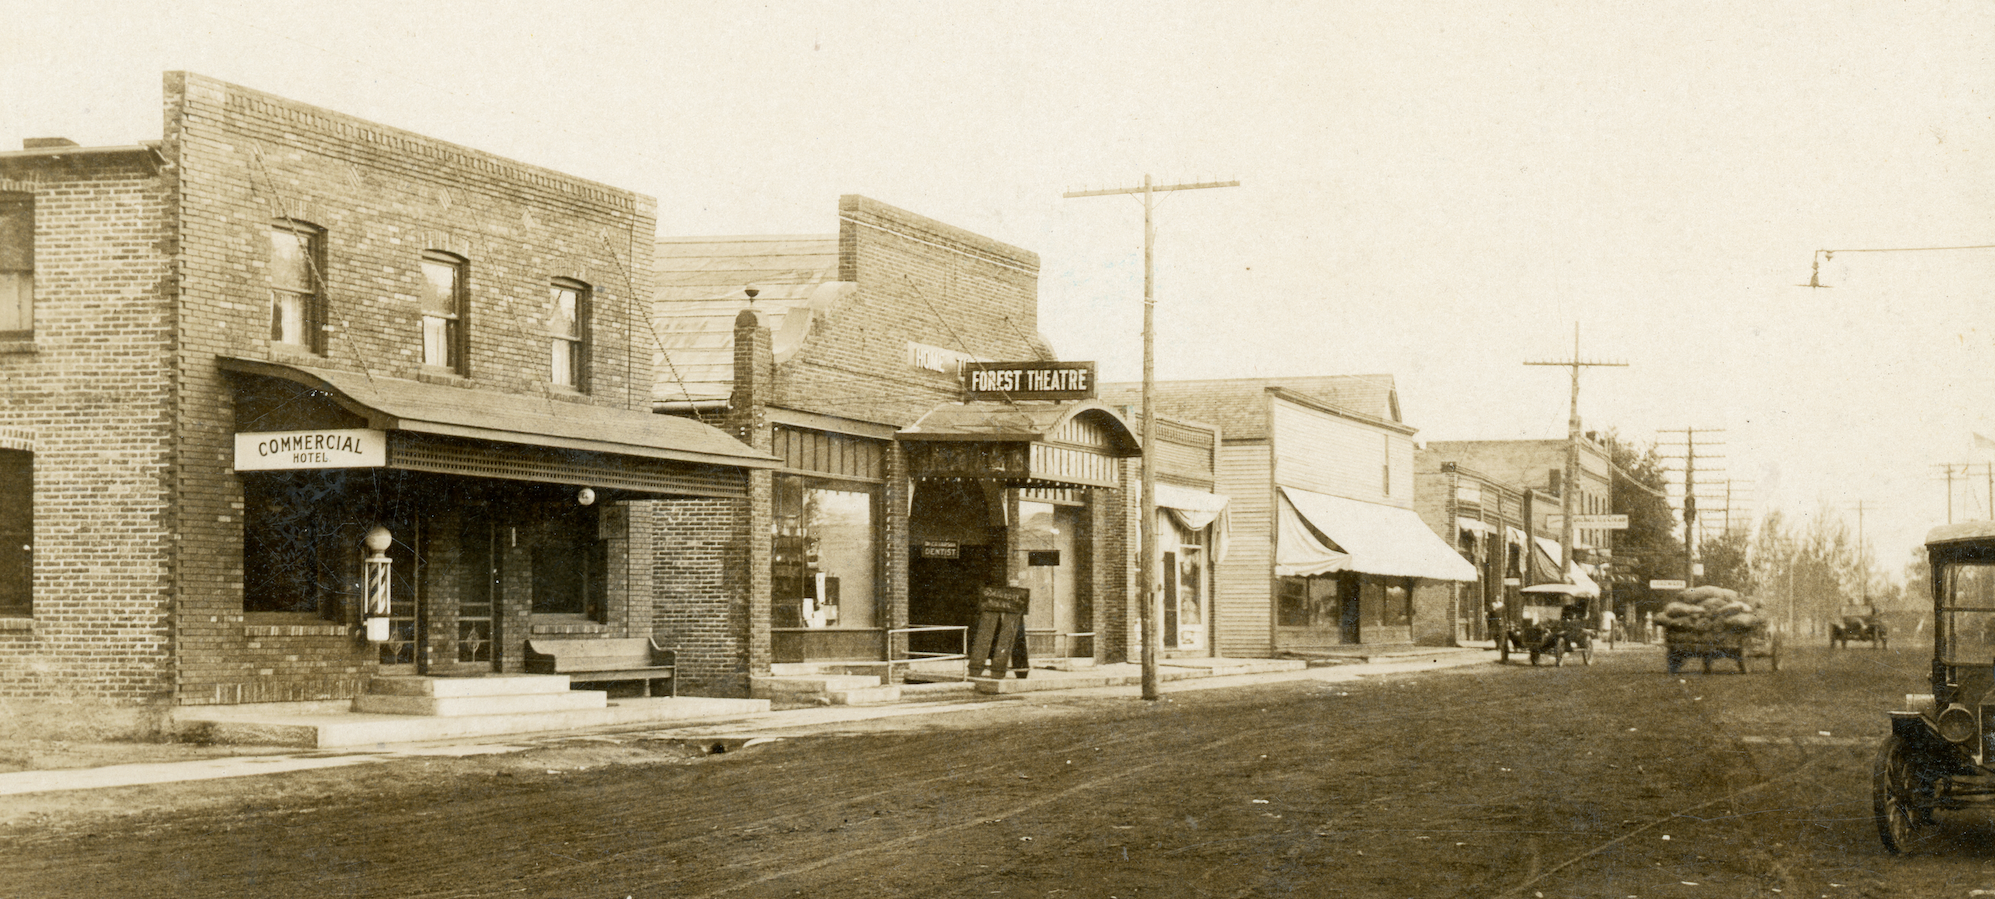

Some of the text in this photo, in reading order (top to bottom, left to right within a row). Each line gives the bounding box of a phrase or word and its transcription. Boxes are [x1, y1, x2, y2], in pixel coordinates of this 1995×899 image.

[914, 348, 945, 373] HOME
[972, 369, 1088, 392] FOREST THEATRE
[258, 434, 363, 457] COMMERCIAL
[924, 547, 957, 556] DENTIST
